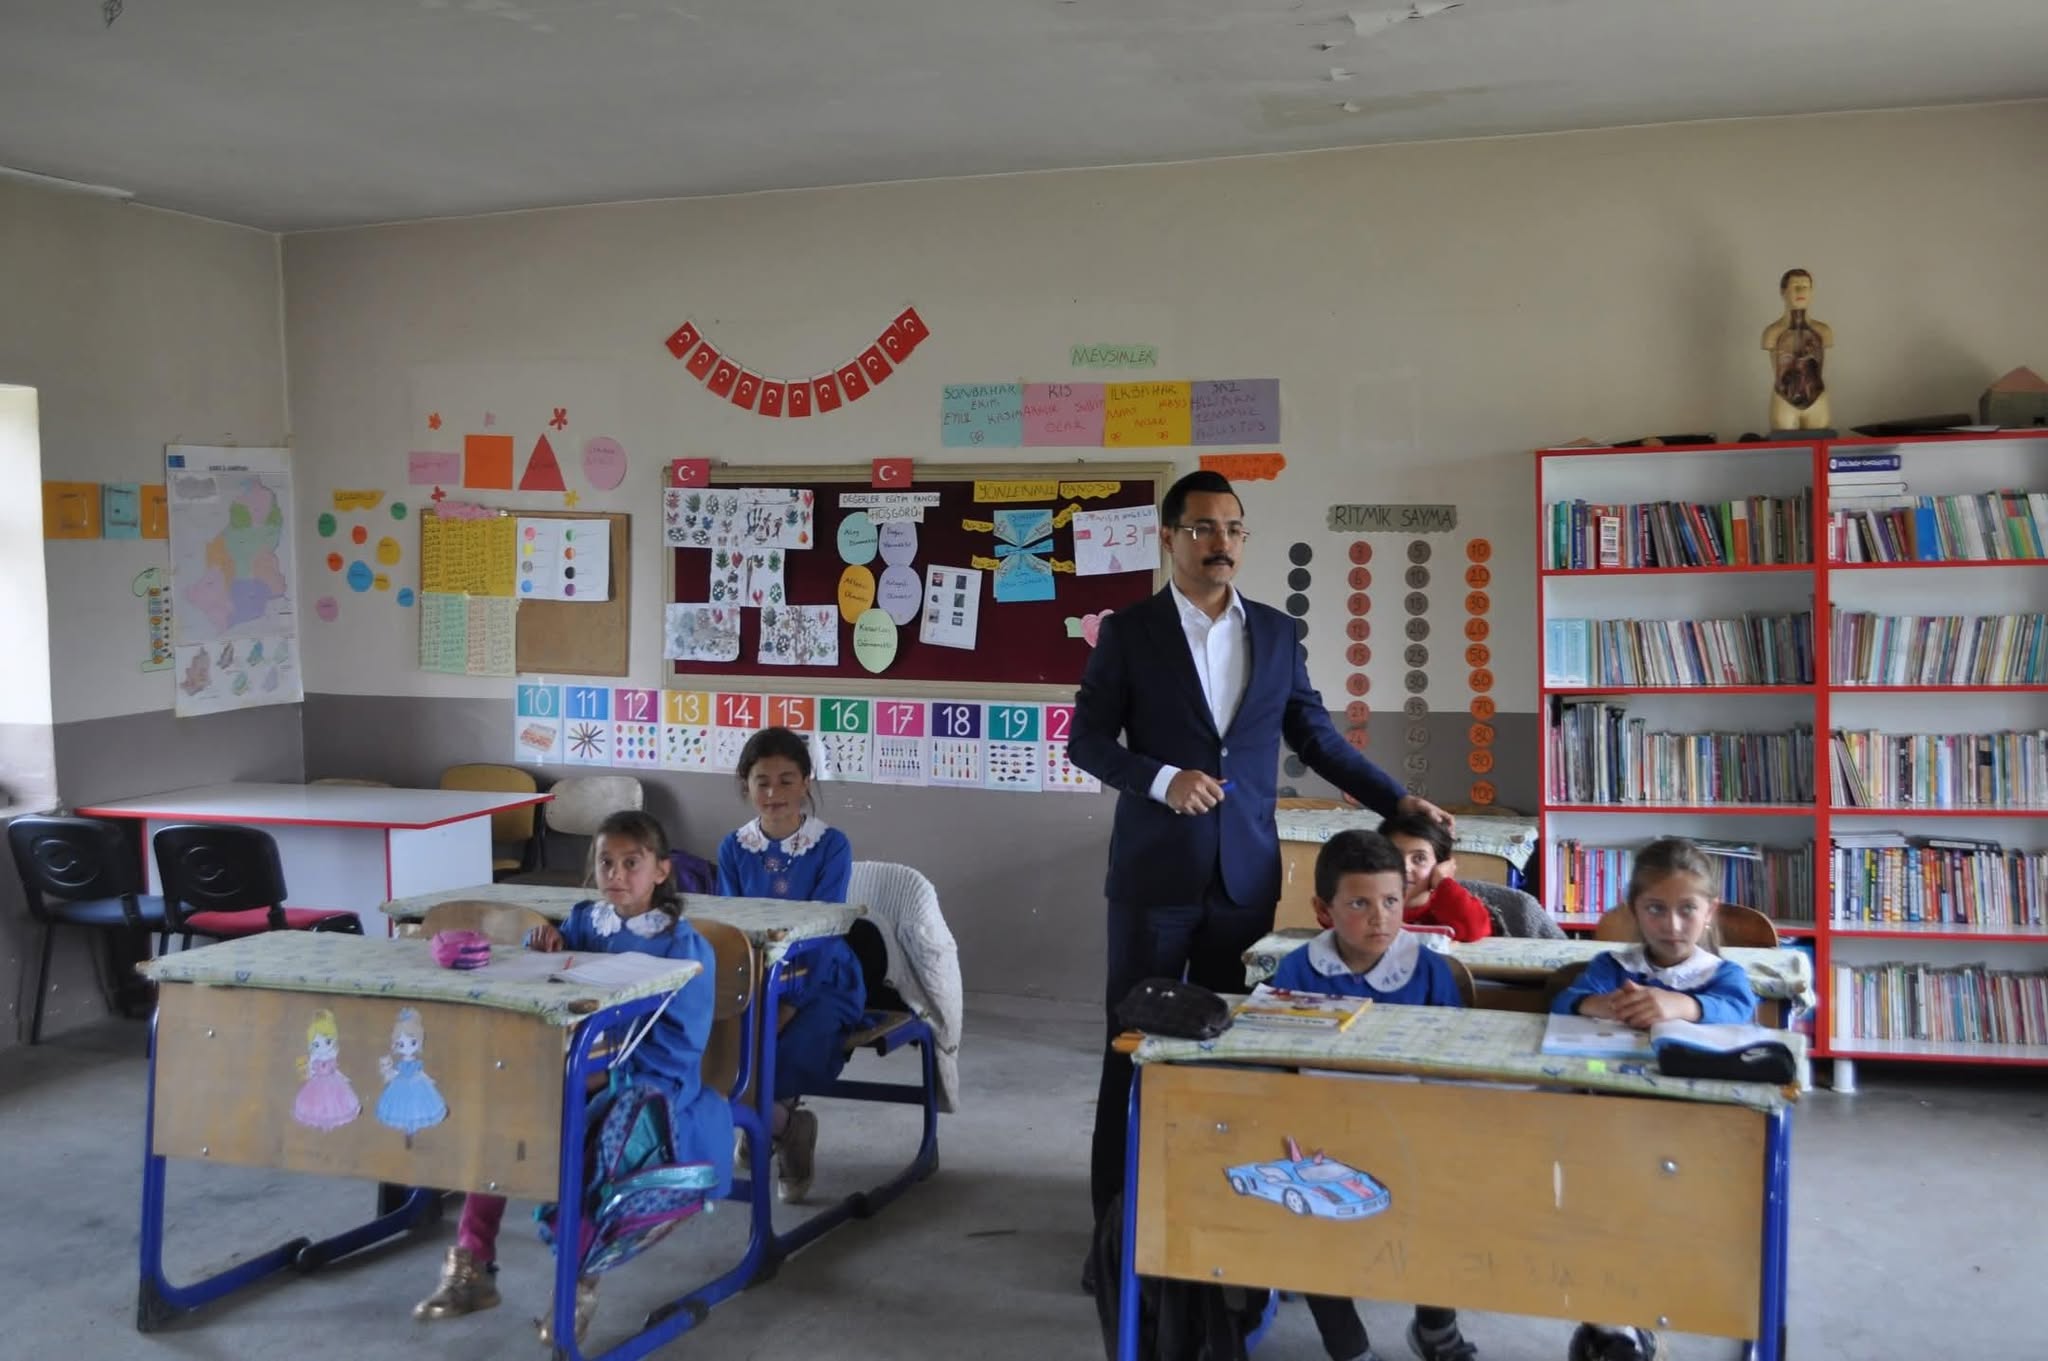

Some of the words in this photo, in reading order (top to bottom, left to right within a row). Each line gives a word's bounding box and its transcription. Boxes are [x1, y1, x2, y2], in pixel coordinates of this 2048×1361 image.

[1400, 508, 1455, 529] SAYMA
[1413, 543, 1425, 558] 5
[1471, 543, 1488, 557] 10
[1410, 569, 1425, 584] 10
[1410, 597, 1423, 611] 15
[1409, 621, 1425, 635] 20
[1408, 649, 1425, 664] 25
[1408, 674, 1424, 690] 30
[524, 687, 551, 716] 10
[576, 690, 597, 718] 11
[623, 692, 649, 720] 12
[672, 694, 700, 722] 13
[723, 697, 754, 725] 14
[777, 700, 805, 728] 15
[830, 701, 860, 730] 16
[887, 704, 914, 734] 17
[942, 706, 971, 736] 18
[999, 709, 1028, 738] 19
[1052, 709, 1070, 738] 2
